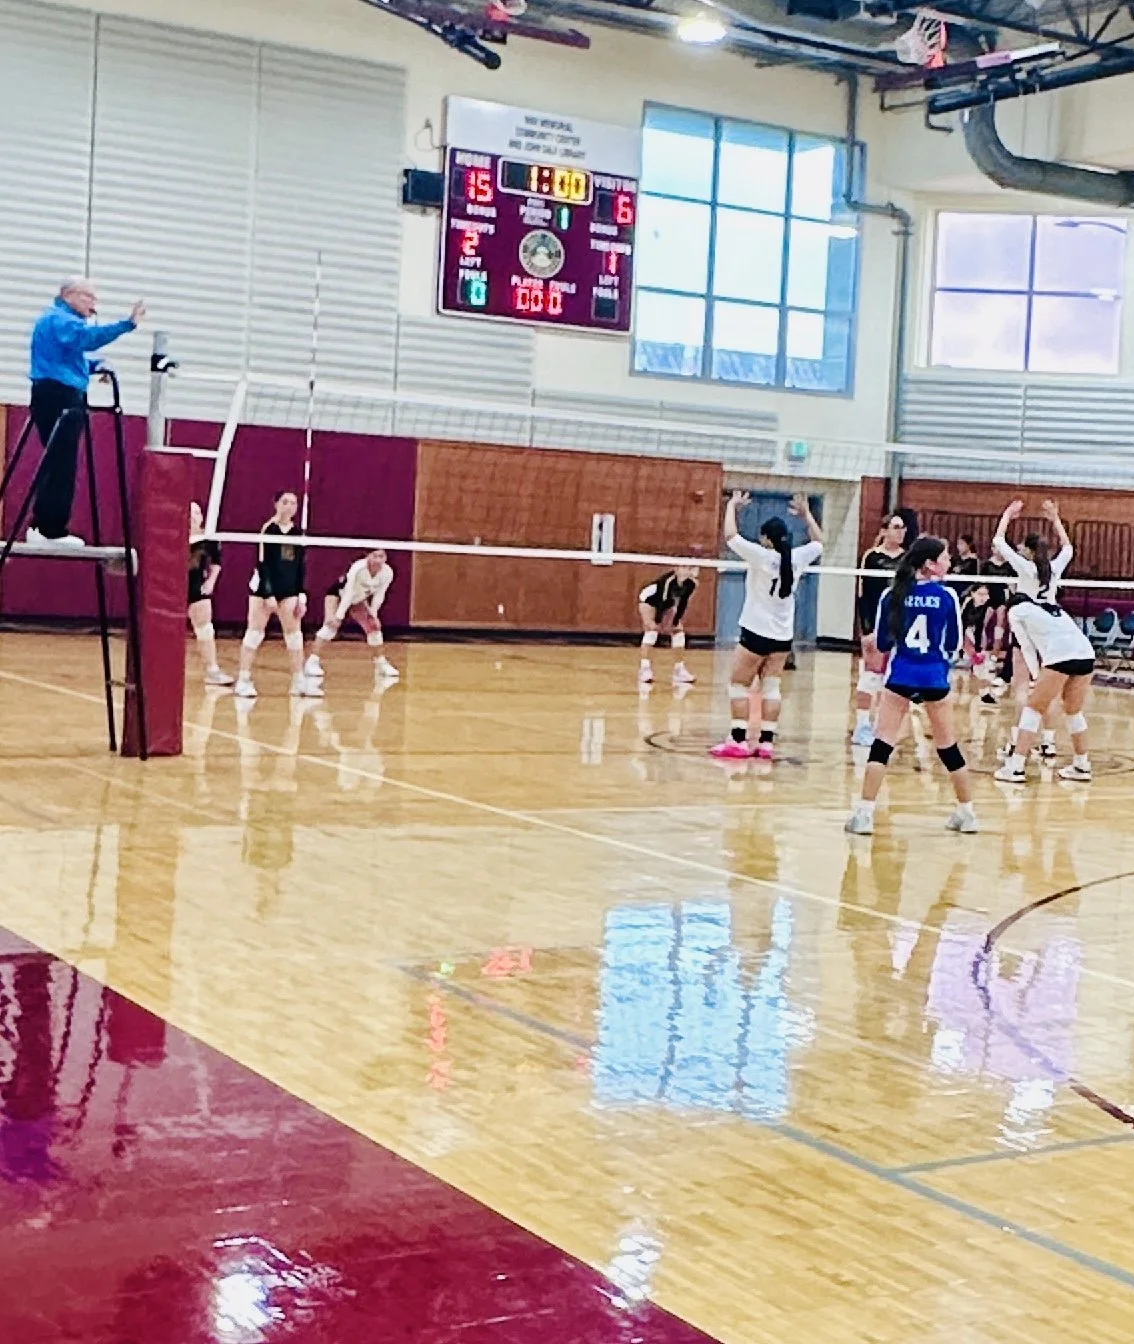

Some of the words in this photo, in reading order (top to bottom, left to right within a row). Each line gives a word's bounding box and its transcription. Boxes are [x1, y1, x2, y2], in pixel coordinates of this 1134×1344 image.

[467, 170, 494, 202] 15
[530, 165, 586, 201] 1:00
[616, 195, 632, 224] 6
[462, 232, 479, 256] 2
[471, 282, 486, 305] 0
[904, 614, 930, 653] 4
